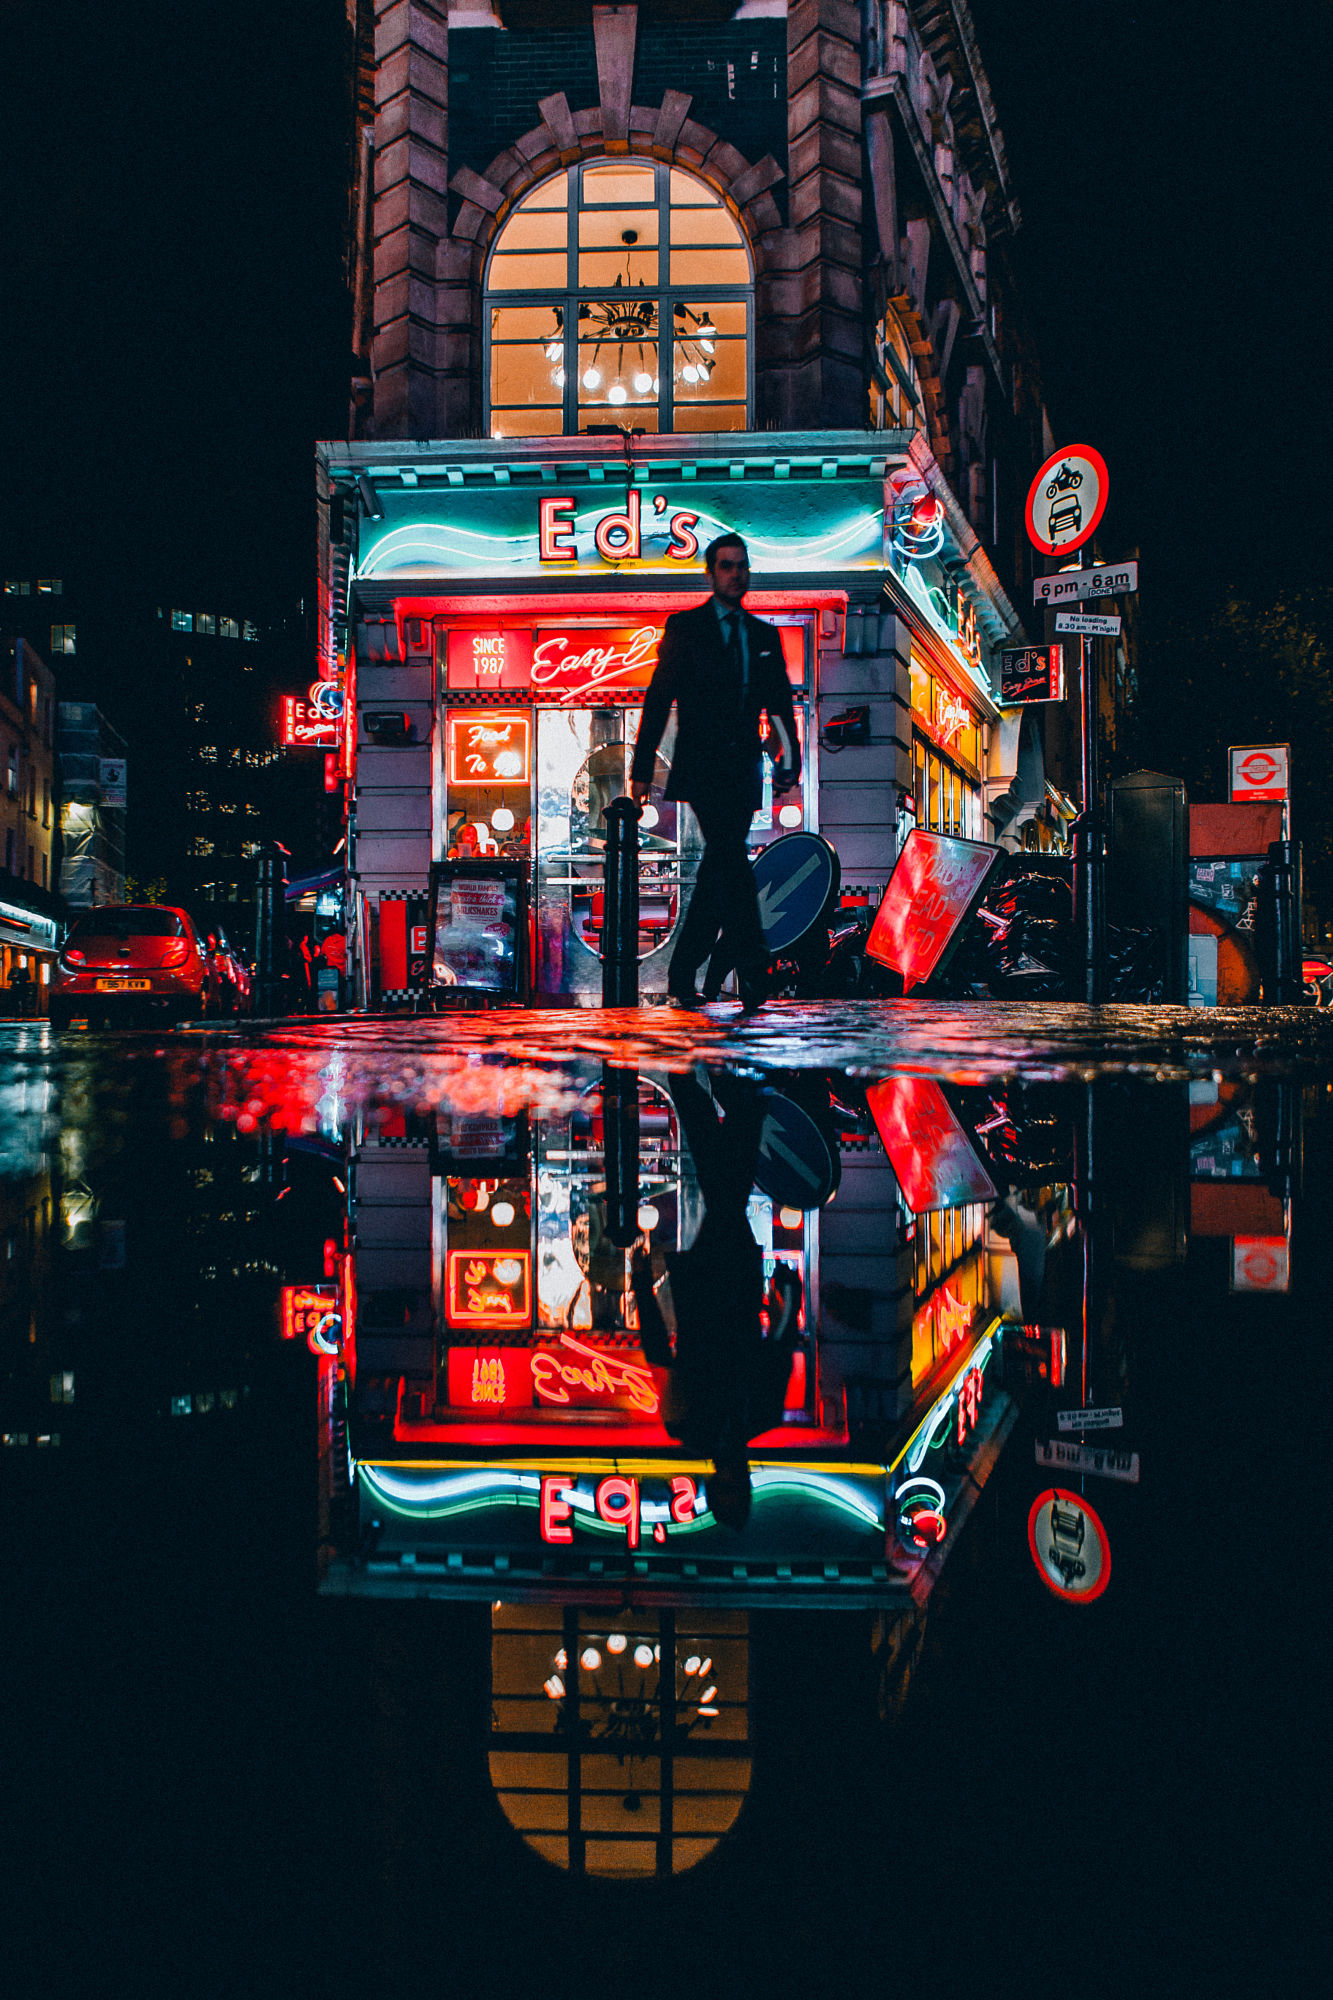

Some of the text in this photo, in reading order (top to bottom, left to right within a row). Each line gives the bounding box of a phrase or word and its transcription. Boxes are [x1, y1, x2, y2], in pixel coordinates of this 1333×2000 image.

[539, 489, 700, 561] Ed's
[1081, 616, 1108, 625] loading
[472, 637, 505, 655] SINCE
[473, 657, 505, 674] 1987
[531, 637, 622, 684] Easy
[1001, 651, 1046, 674] Ed's
[468, 724, 511, 747] Food
[465, 754, 486, 773] To
[458, 883, 477, 892] WORLD
[877, 917, 936, 957] CLSED
